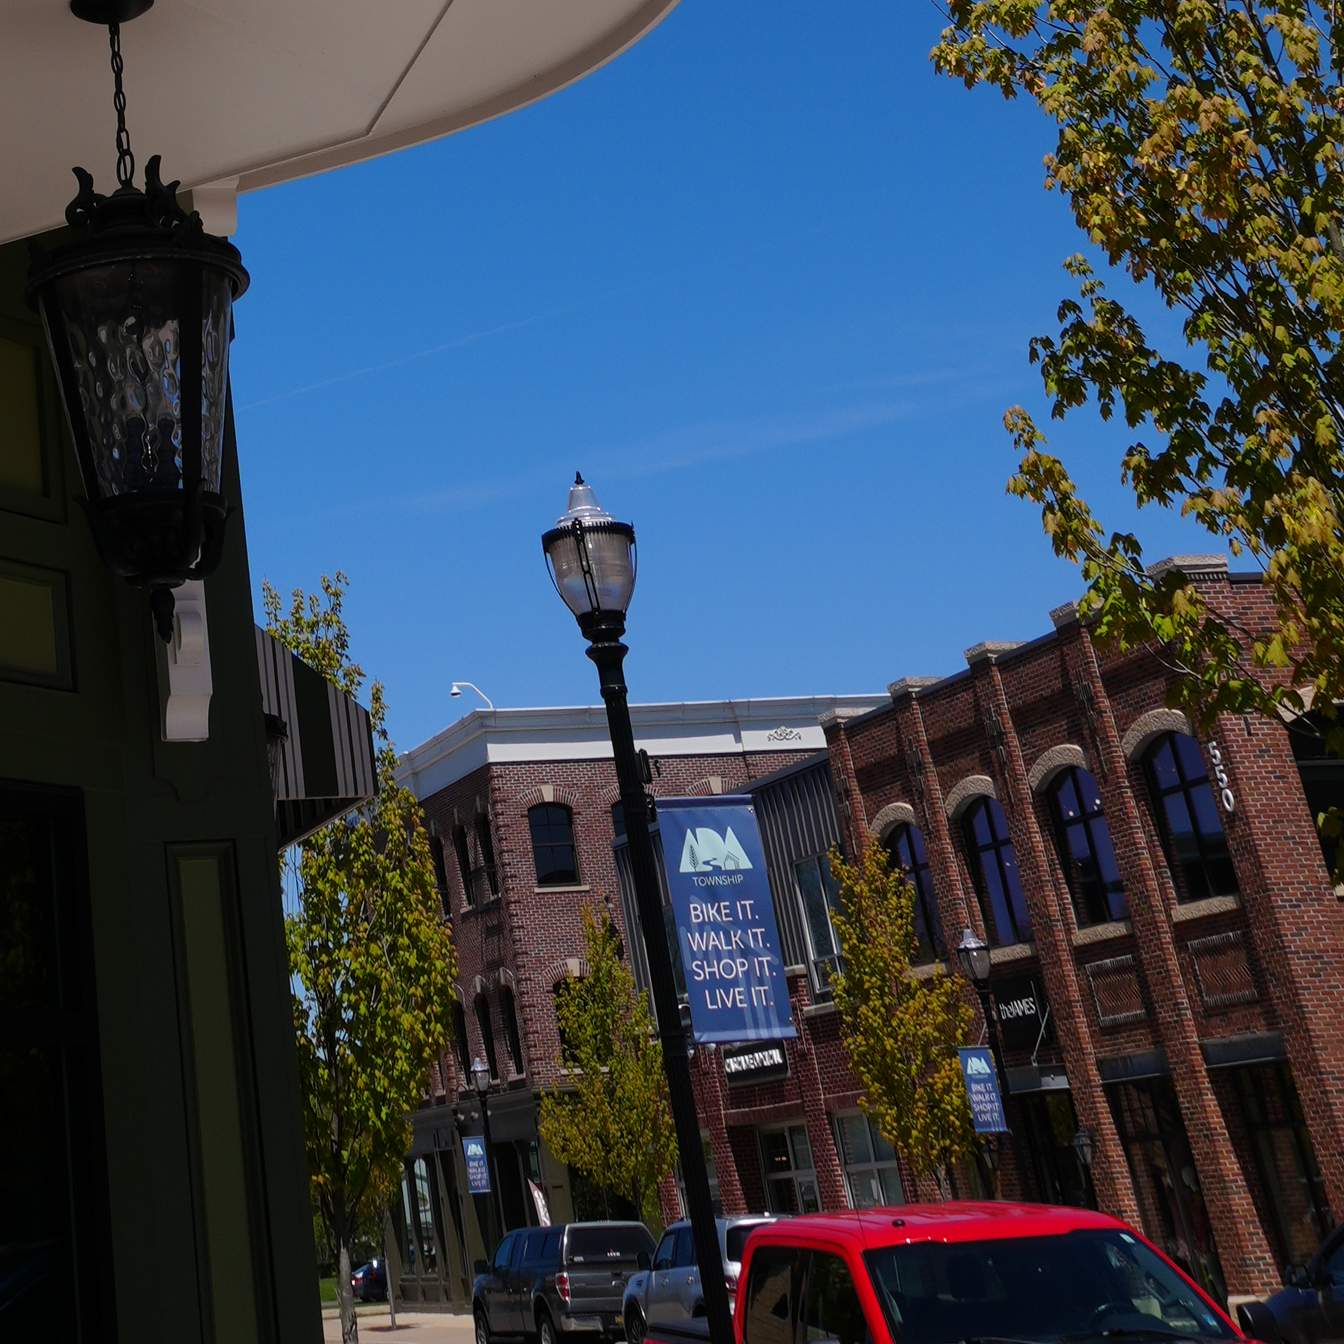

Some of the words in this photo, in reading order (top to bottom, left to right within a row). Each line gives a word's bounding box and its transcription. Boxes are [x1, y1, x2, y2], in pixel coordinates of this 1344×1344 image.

[1208, 741, 1235, 812] 550
[692, 874, 745, 887] TOWNSHIP
[689, 901, 733, 923] BIKE
[736, 900, 759, 921] IT.
[687, 929, 746, 952] WALK
[748, 928, 771, 949] IT.
[692, 958, 748, 981] SHOP
[754, 957, 777, 978] IT.
[704, 987, 748, 1010] LIVE
[751, 986, 774, 1007] IT.
